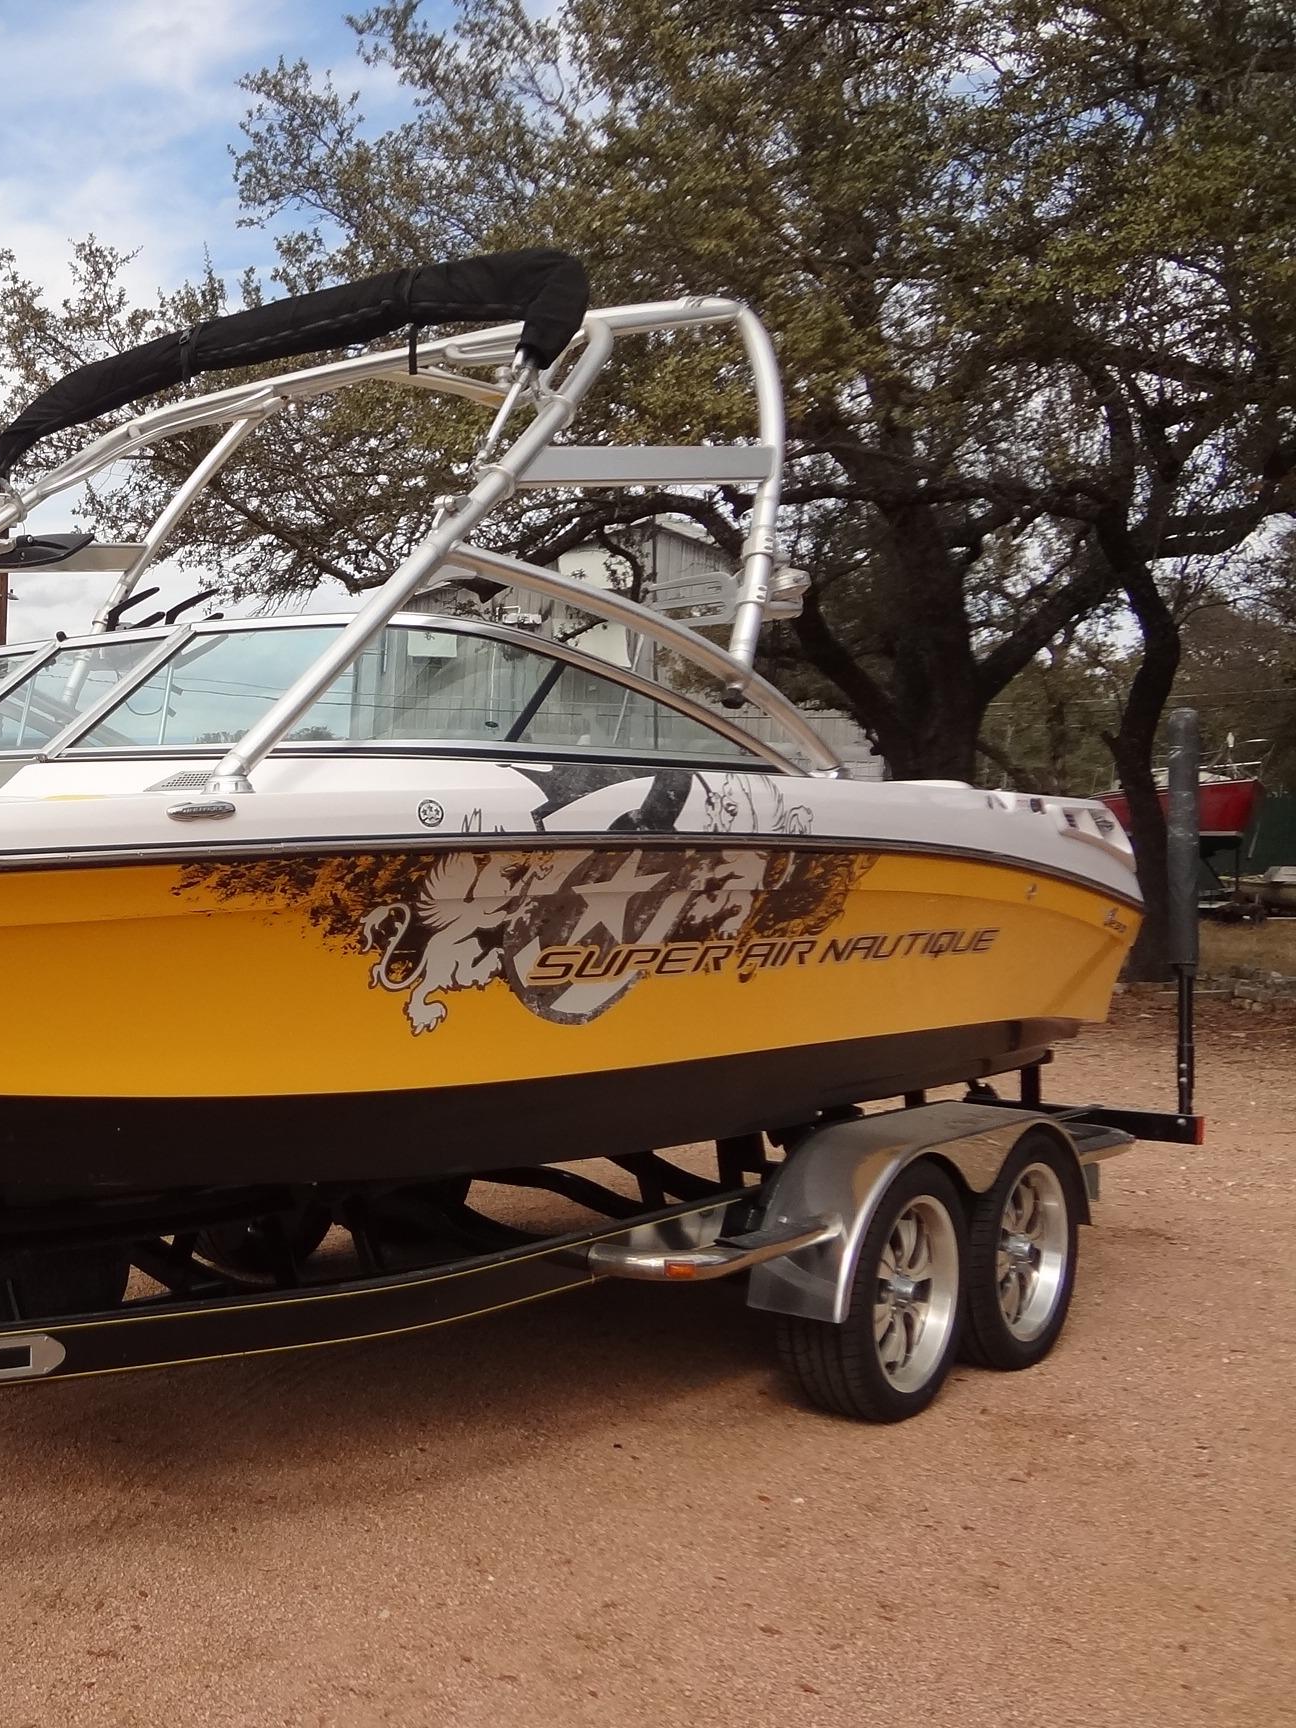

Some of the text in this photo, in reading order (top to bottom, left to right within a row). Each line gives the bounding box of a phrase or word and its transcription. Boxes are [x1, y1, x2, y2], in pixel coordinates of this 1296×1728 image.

[529, 927, 1000, 985] SUPER AIR NAUTIQUE
